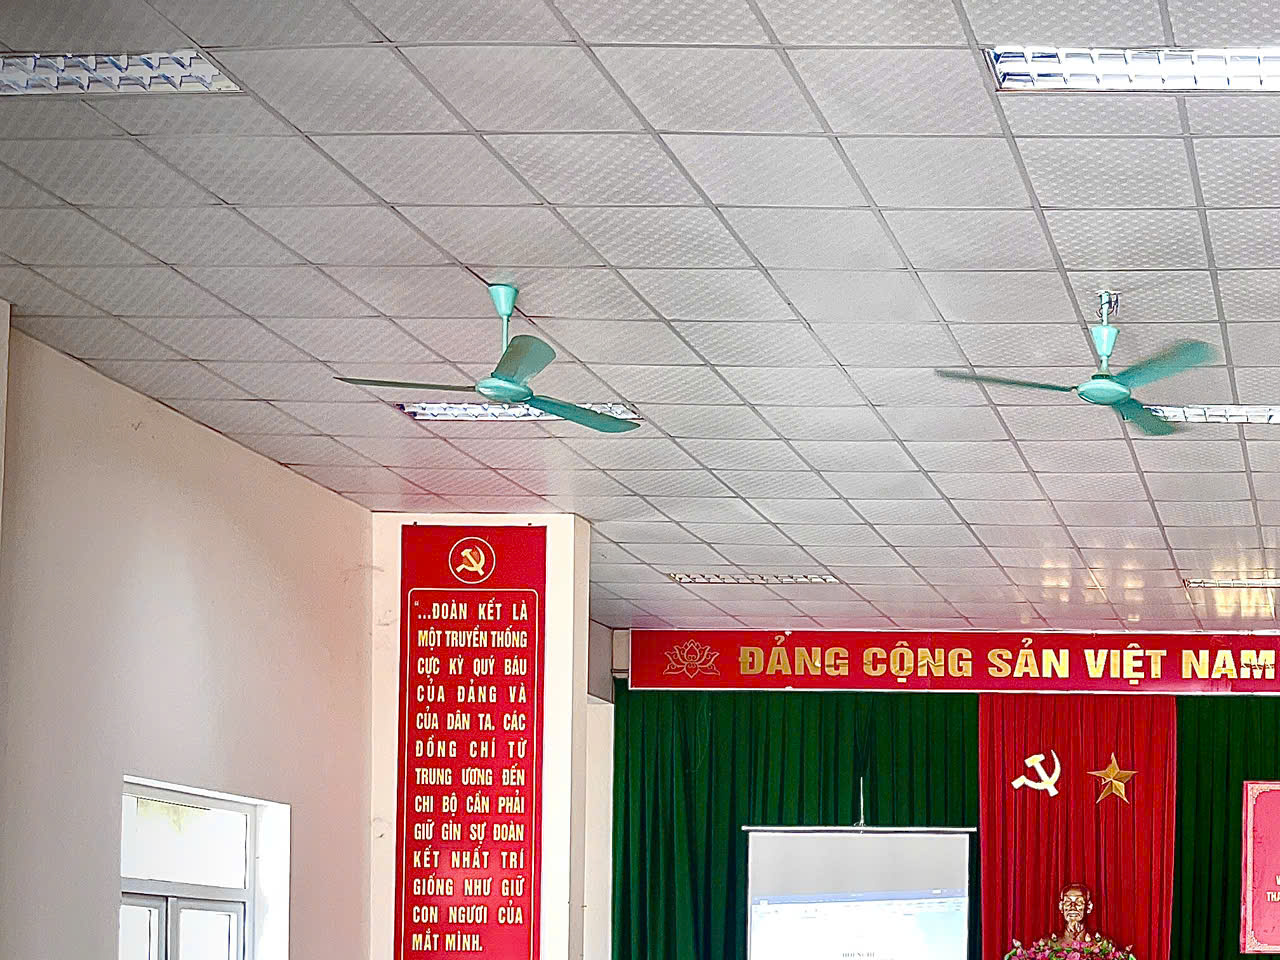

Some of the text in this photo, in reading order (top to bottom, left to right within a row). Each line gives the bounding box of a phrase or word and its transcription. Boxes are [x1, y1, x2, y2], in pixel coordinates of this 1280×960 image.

[478, 597, 502, 620] KẾT
[513, 600, 528, 621] LÀ
[418, 625, 527, 651] MỘT TRUYỀN THỐNG
[417, 654, 527, 678] CỰC KỲ QUÝ BÁU
[738, 635, 849, 676] ĐẢNG
[863, 641, 973, 683] CỘNG
[988, 637, 1069, 678] SẢN
[1084, 643, 1167, 685] VIỆT
[1182, 649, 1276, 679] NAM
[417, 678, 526, 703] CỦA ĐẢNG VÀ
[416, 706, 526, 731] CỦA DÂN TA. CÁC
[416, 734, 527, 758] ĐỒNG CHÍ TỪ
[415, 763, 525, 786] TRUNG ƯƠNG ĐẾN
[415, 789, 525, 817] CHI BỘ CẦN PHẢI
[414, 819, 524, 844] GIỮ GÌN SỰ ĐOÀN
[414, 845, 524, 869] KẾT NHẤT TRÍ
[413, 872, 525, 896] GIỐNG NHƯ GIỮ
[413, 900, 523, 924] CON NGƯƠI CỦA
[412, 928, 483, 951] MẮT MÌNH.
